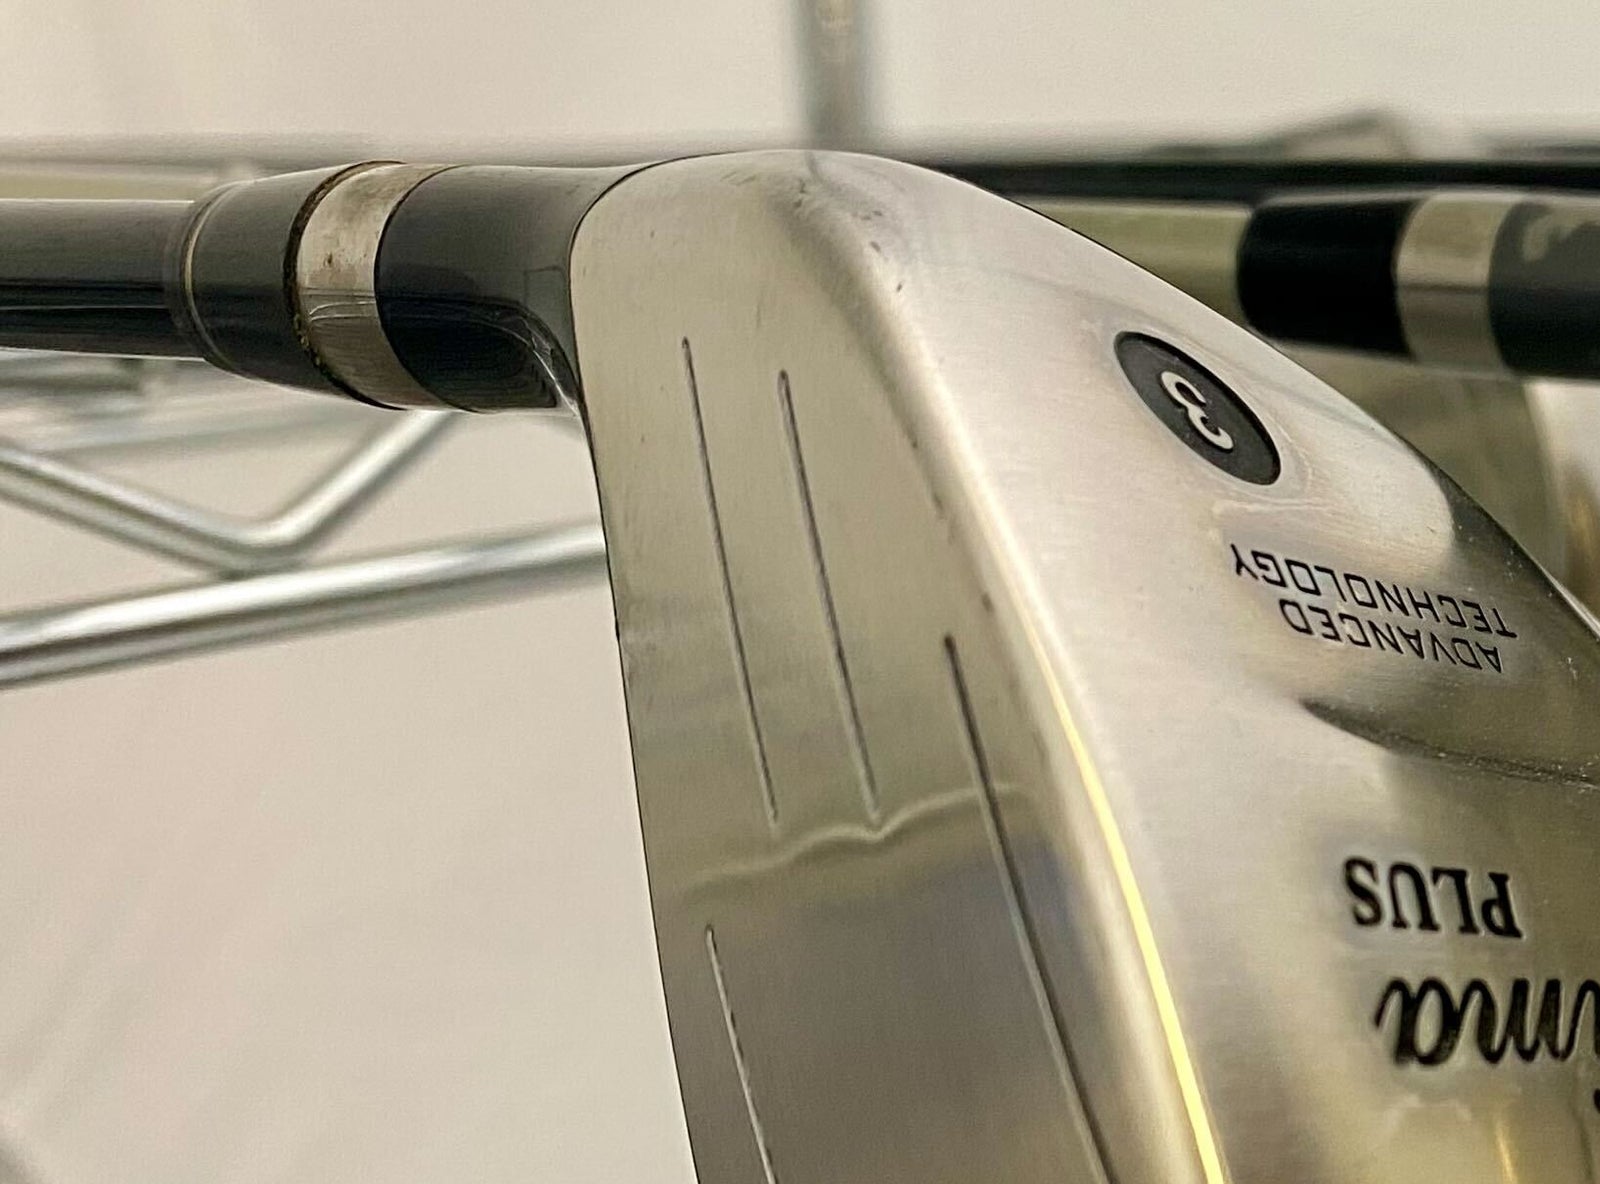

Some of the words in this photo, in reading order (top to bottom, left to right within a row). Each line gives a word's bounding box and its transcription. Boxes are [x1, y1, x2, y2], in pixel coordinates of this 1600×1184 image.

[1160, 369, 1234, 452] 3
[1229, 543, 1518, 639] TECHNOLOGY
[1279, 597, 1502, 674] ADVANCED
[1343, 856, 1524, 939] PLUS
